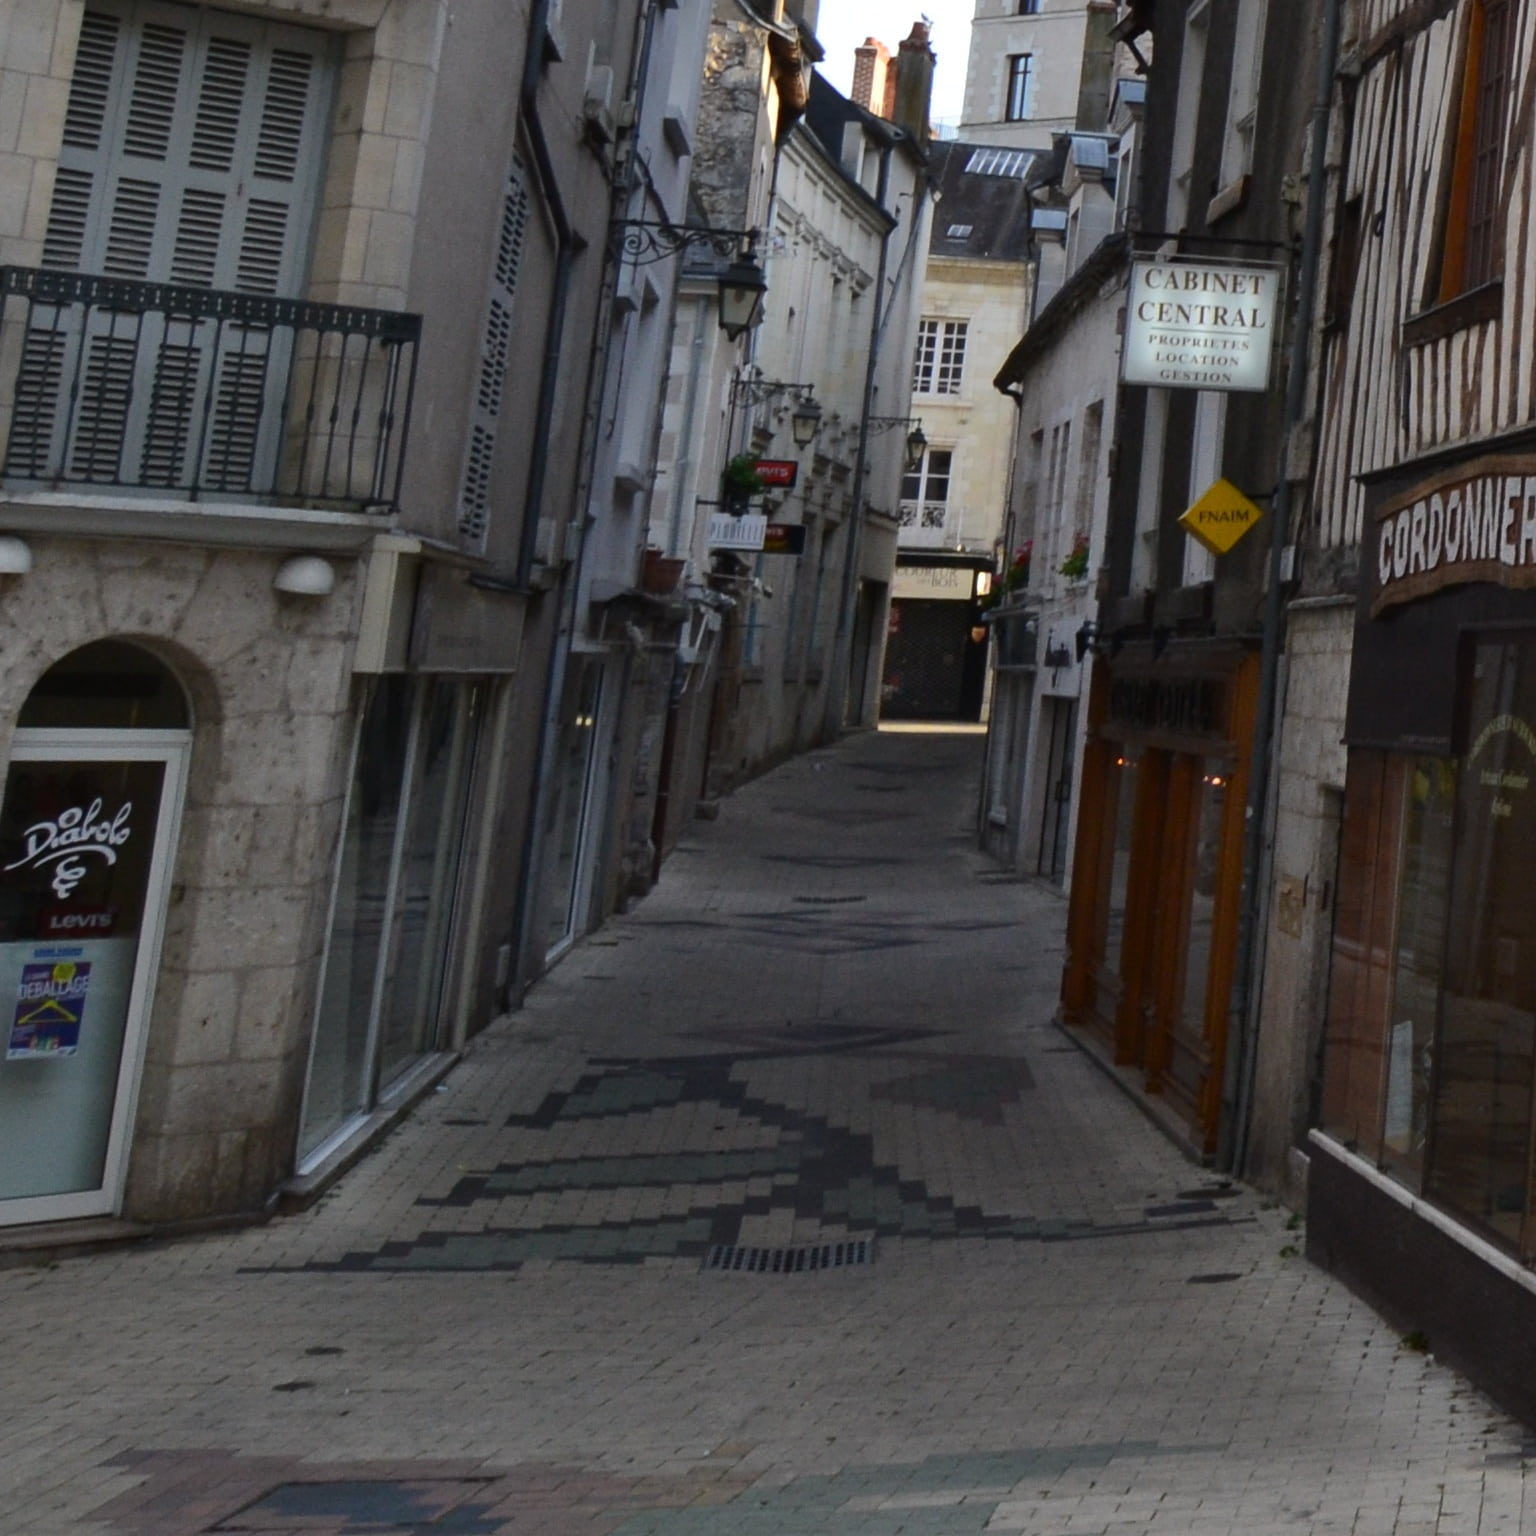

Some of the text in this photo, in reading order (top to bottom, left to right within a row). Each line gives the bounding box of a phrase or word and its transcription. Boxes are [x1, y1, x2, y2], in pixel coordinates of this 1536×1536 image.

[1144, 268, 1266, 296] CABINET
[1137, 300, 1266, 329] CENTRAL
[1155, 351, 1240, 366] LOCATION
[1160, 368, 1233, 383] GESTION
[1199, 509, 1250, 524] FNAIM
